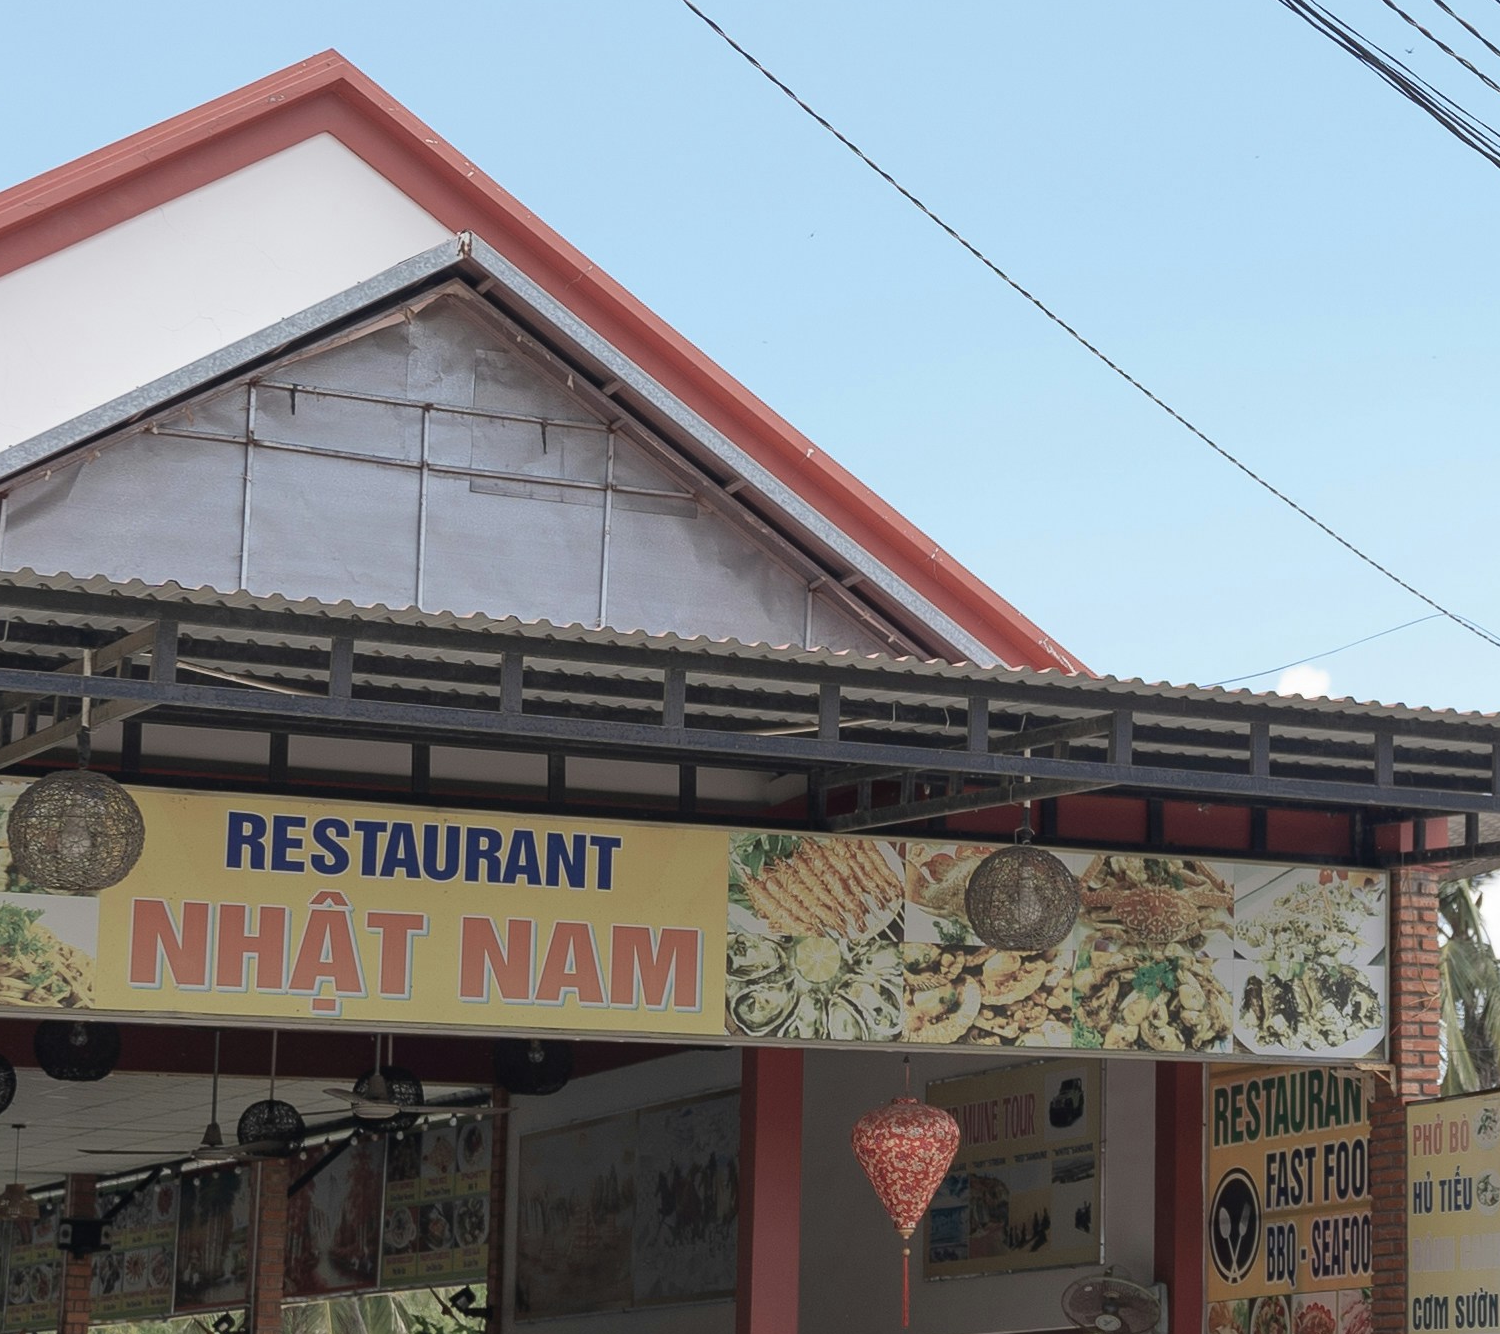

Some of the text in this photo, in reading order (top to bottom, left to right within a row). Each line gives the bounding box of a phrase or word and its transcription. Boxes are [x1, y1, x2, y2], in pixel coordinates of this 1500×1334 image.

[224, 810, 622, 891] RESTAURANT
[127, 890, 703, 1017] NHẬT NAM
[1003, 1093, 1036, 1140] TOUR
[1213, 1068, 1371, 1148] RESTAURAN
[1413, 1113, 1470, 1157] PHỞ BÒ
[1265, 1137, 1372, 1210] FAST FOO
[1413, 1165, 1473, 1215] HỦ TIẾU
[1266, 1222, 1297, 1290] BBQ
[1311, 1214, 1372, 1280] SEAFOO
[1412, 1287, 1499, 1331] CƠM SƯỜN
